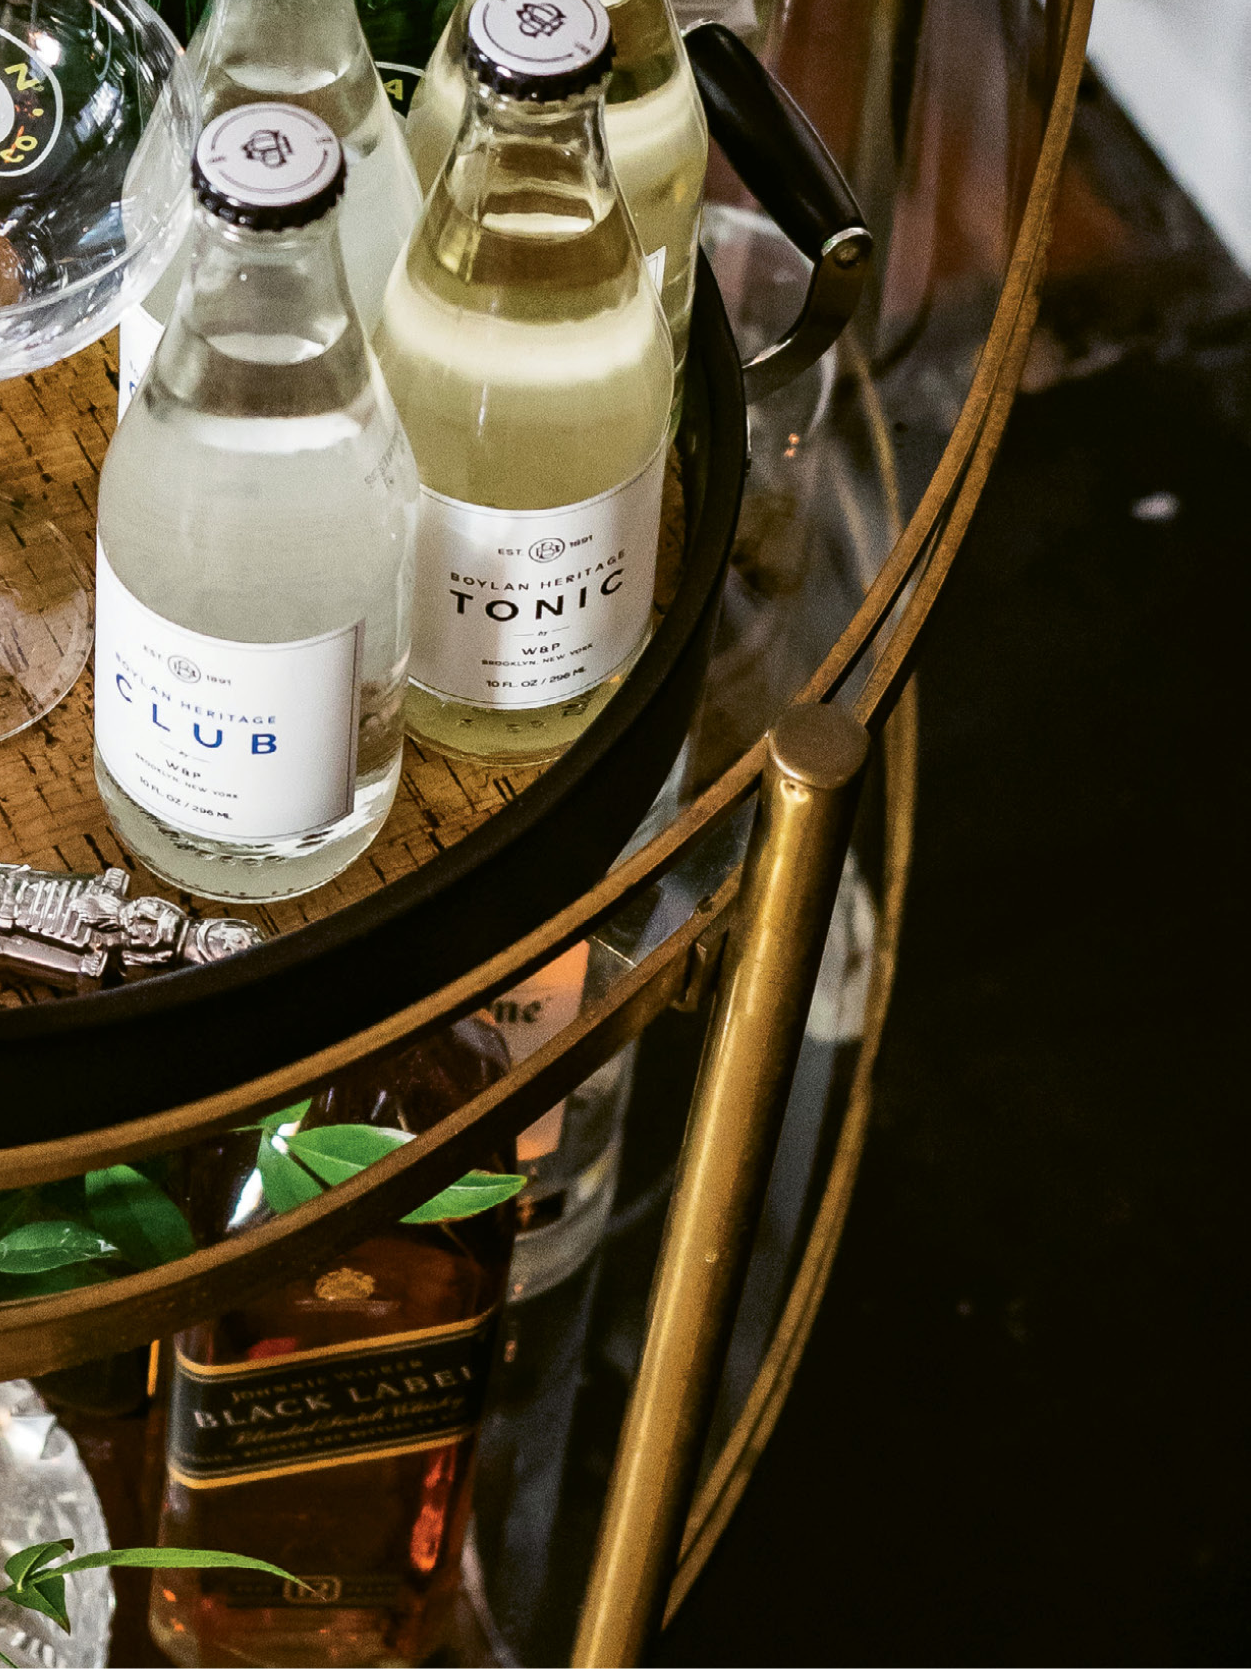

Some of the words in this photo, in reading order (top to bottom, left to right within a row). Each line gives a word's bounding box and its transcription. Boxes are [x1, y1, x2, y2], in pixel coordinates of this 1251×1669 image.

[569, 534, 593, 549] 1891
[450, 571, 530, 591] BOYLAN
[540, 548, 626, 590] HERITAGE
[449, 568, 625, 622] TONIC
[542, 654, 565, 663] NEW
[569, 642, 593, 656] YORK
[115, 651, 172, 702] BOYLAN
[180, 700, 277, 724] HERITAGE
[206, 674, 231, 686] 1891
[486, 680, 500, 688] 10
[521, 679, 538, 688] OZ
[116, 673, 277, 755] CLUB
[139, 775, 150, 787] 10
[166, 793, 182, 806] OZ
[192, 805, 214, 816] 296
[184, 781, 207, 793] NEW
[212, 790, 239, 799] YORK
[192, 1394, 332, 1429] BLACK
